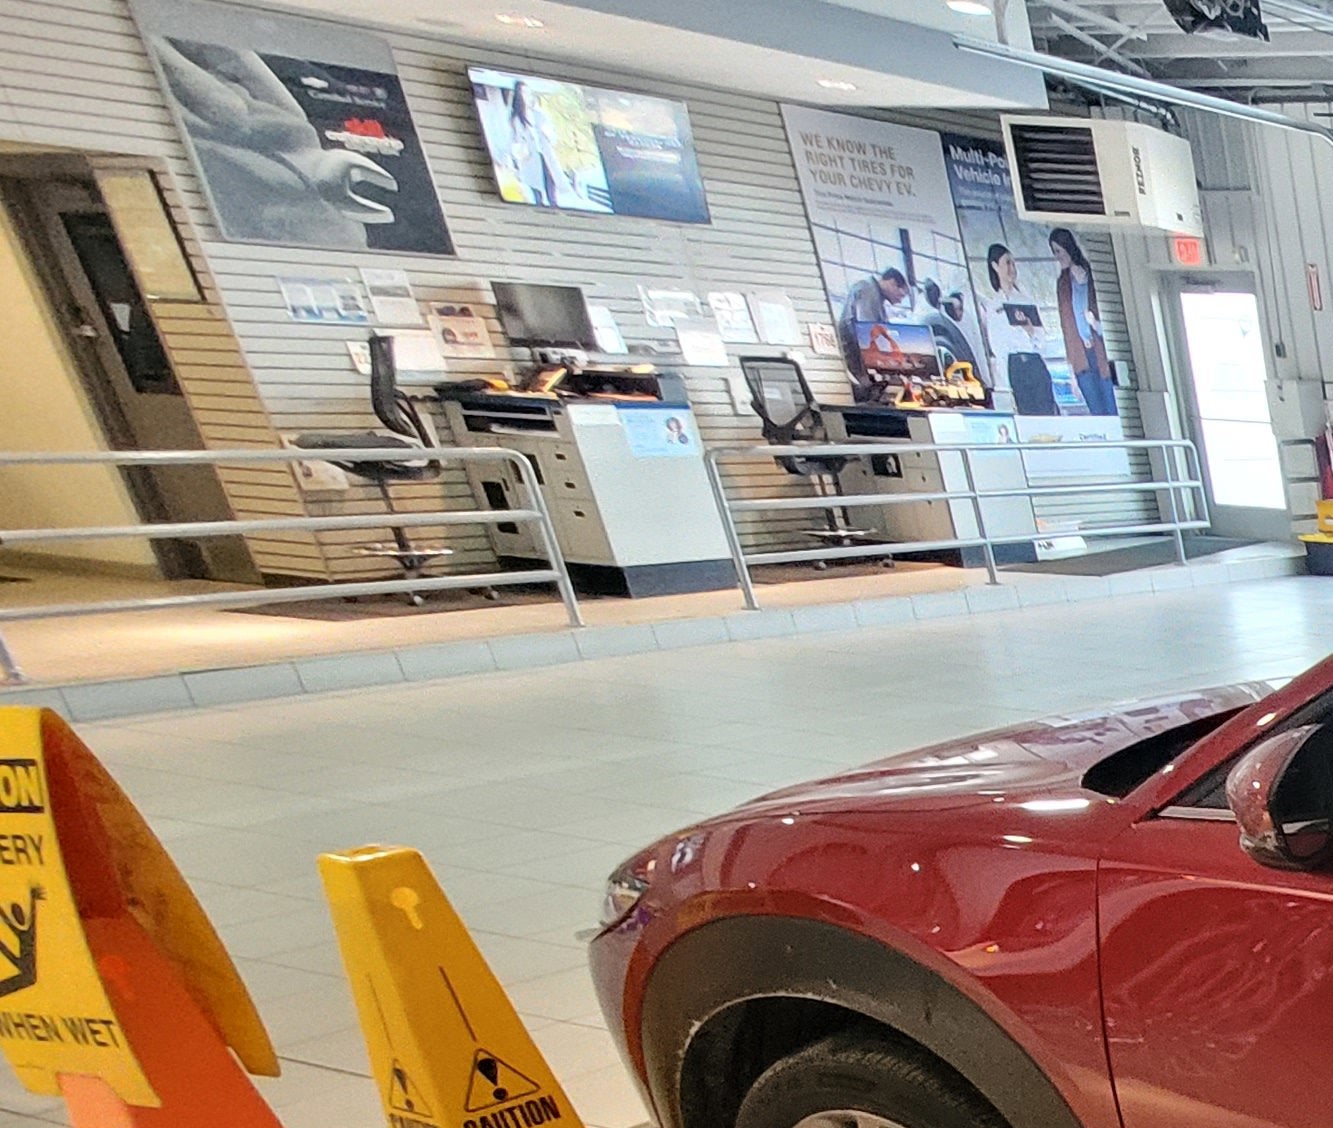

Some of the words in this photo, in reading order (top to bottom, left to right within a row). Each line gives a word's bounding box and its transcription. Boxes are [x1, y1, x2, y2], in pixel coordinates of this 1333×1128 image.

[800, 131, 824, 149] WE
[826, 136, 867, 156] KNOW
[870, 143, 897, 162] THE
[805, 150, 847, 171] RIGHT
[850, 156, 887, 177] TIRES
[890, 163, 916, 181] FOR
[953, 163, 1002, 186] Vehicle
[809, 168, 847, 187] YOUR
[850, 174, 893, 197] CHEVY
[896, 181, 917, 198] EV.
[60, 1016, 119, 1048] WET
